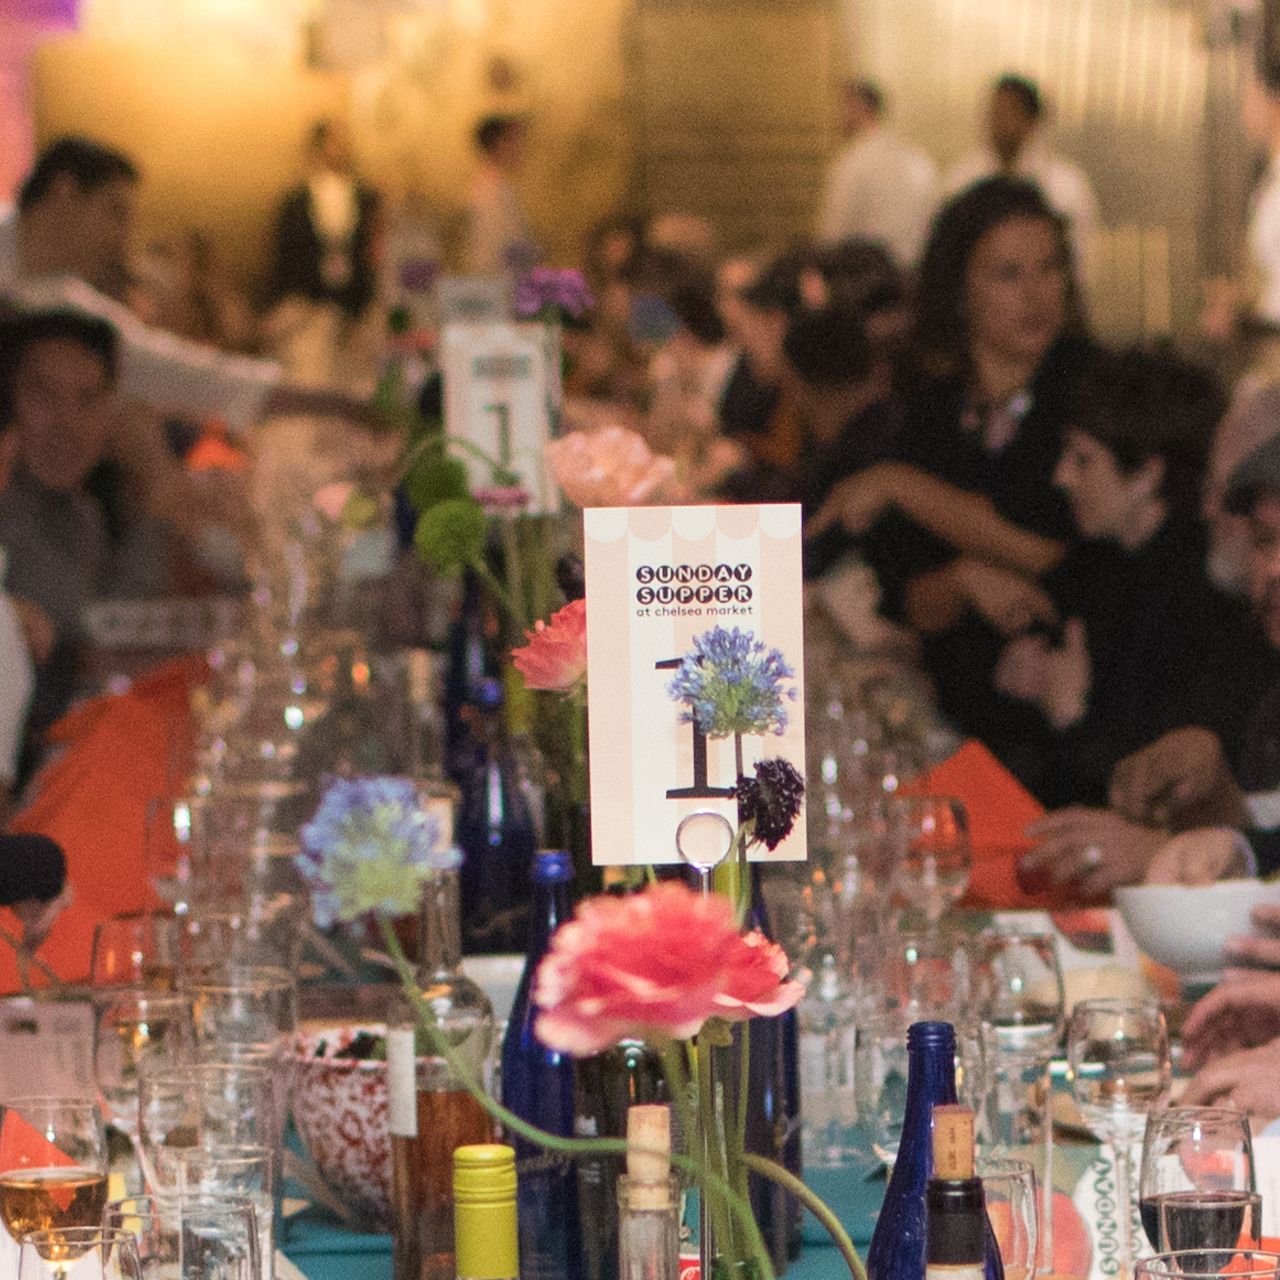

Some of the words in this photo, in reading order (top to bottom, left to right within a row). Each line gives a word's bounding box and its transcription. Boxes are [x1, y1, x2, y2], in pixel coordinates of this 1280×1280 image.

[636, 564, 752, 584] SUNDAY
[636, 585, 753, 605] SUPPER
[636, 605, 651, 617] at
[654, 604, 703, 617] chelsea
[706, 604, 753, 616] market
